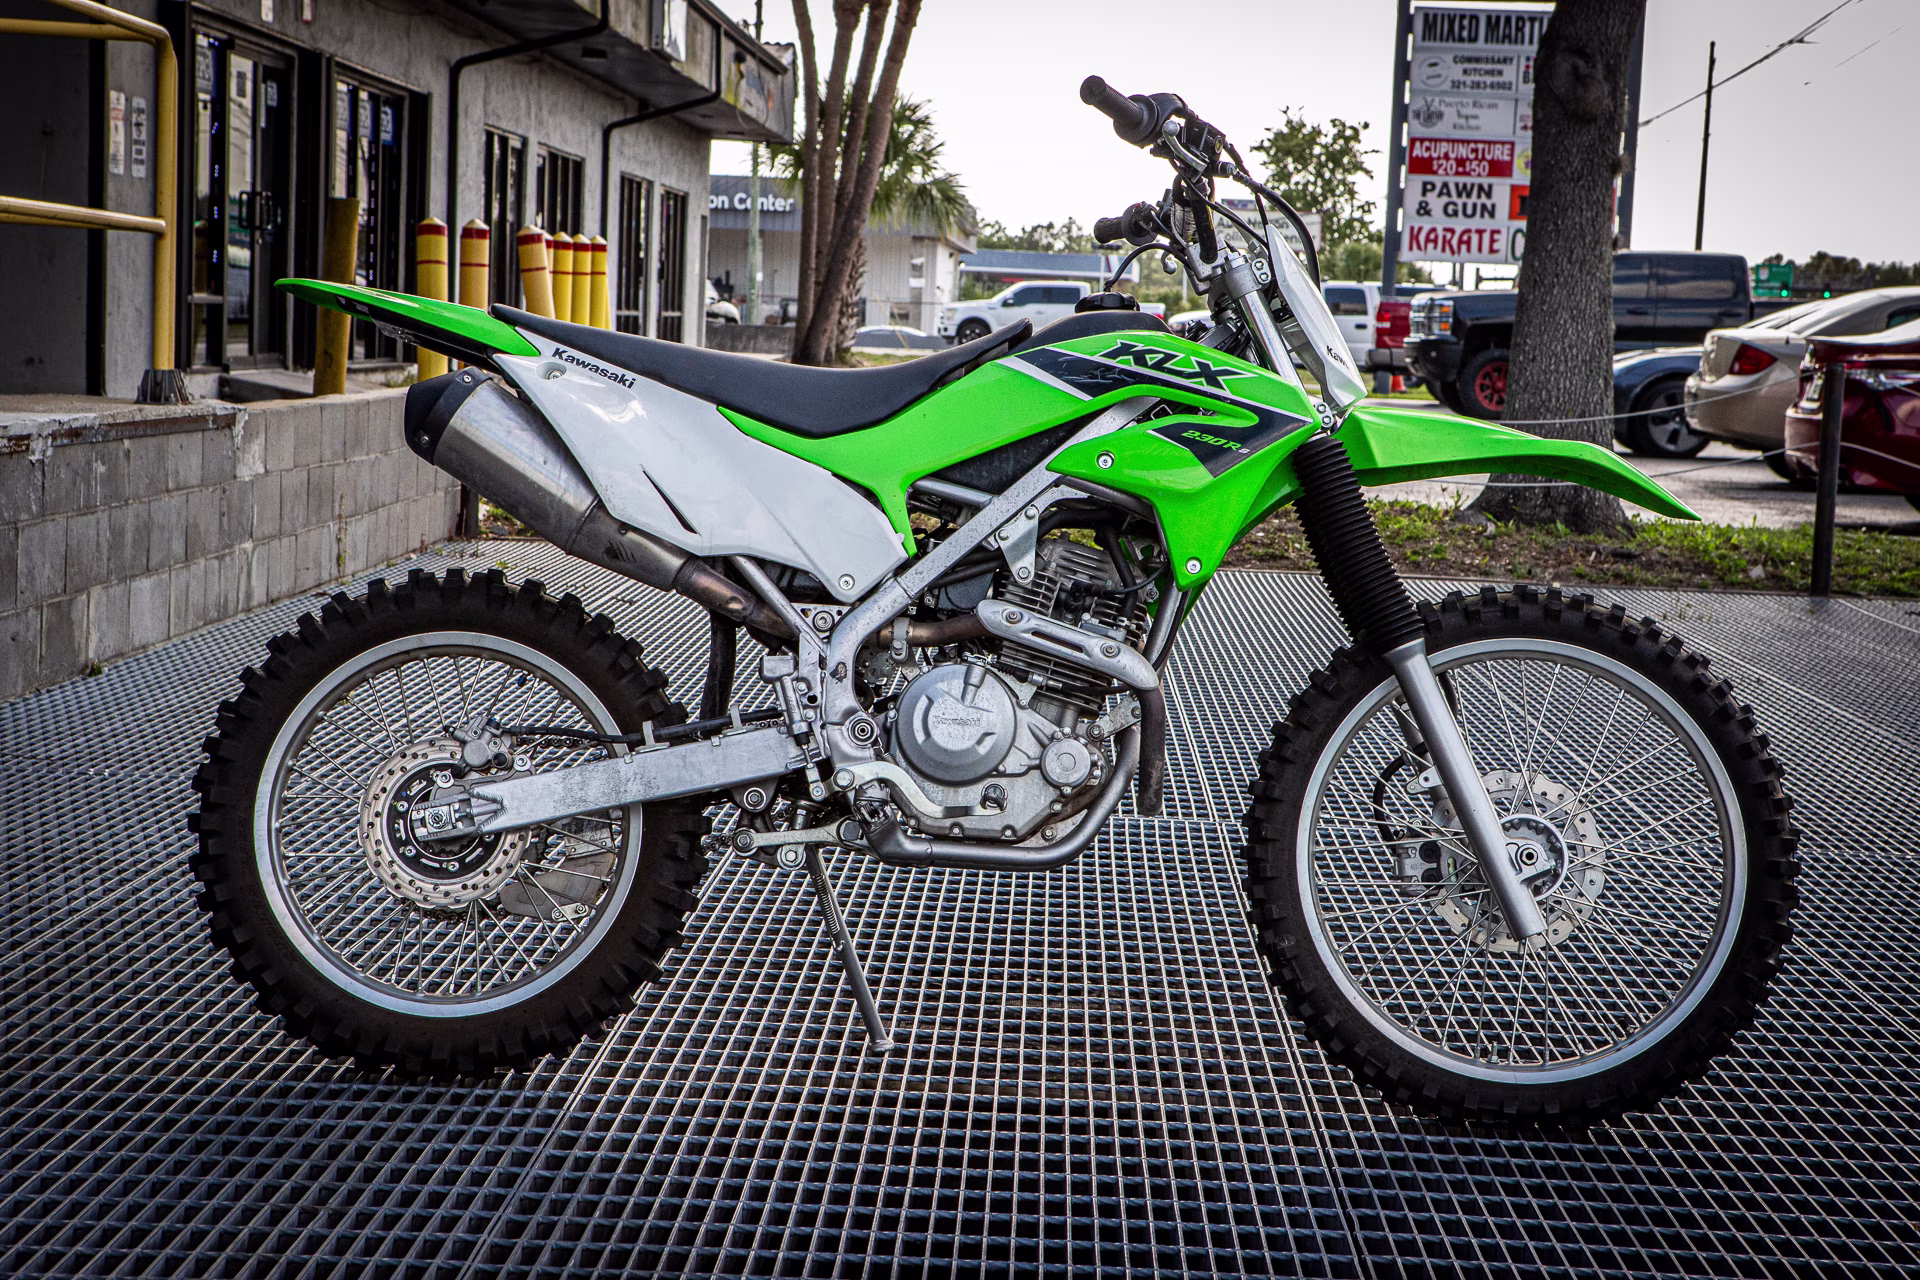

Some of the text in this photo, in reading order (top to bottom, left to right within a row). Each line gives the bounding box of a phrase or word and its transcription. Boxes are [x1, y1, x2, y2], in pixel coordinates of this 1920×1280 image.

[1421, 12, 1480, 44] MIXED
[1452, 54, 1514, 65] COMMISSARY
[1462, 67, 1504, 77] KITCHEN
[1412, 140, 1512, 161] ACUPUNCTURE
[1421, 181, 1493, 200] PAWN
[1416, 200, 1496, 220] & GUN
[1408, 225, 1502, 257] KARATE
[551, 347, 637, 389] Kawasaki
[1096, 339, 1260, 396] KLX
